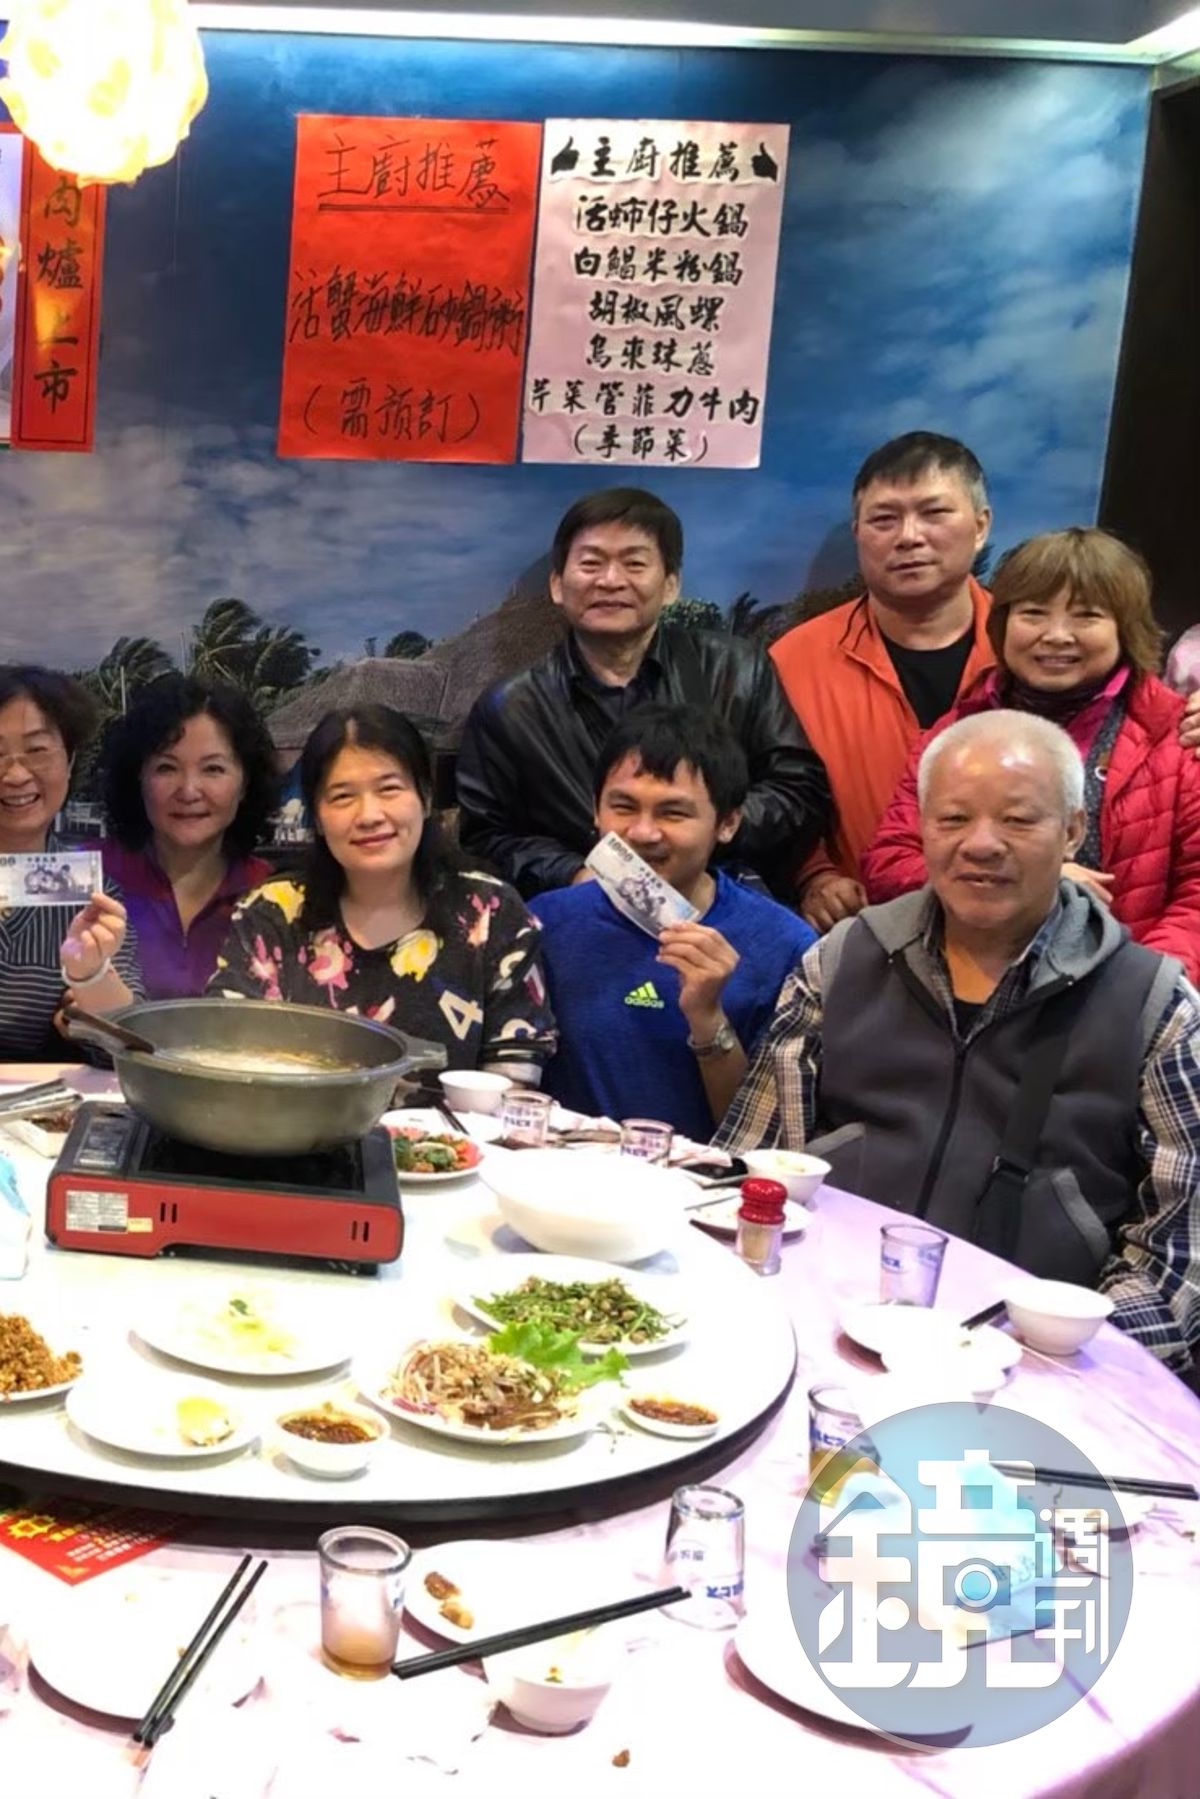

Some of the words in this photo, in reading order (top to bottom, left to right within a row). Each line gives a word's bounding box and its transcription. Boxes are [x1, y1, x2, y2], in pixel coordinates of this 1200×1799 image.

[317, 133, 511, 209] 主廚推薦
[590, 135, 740, 182] 主廚推薦
[588, 290, 724, 333] 胡椒風螺
[531, 377, 760, 426] 芹菜管菲力牛肉
[608, 836, 634, 862] 1000
[624, 995, 665, 1010] adidas
